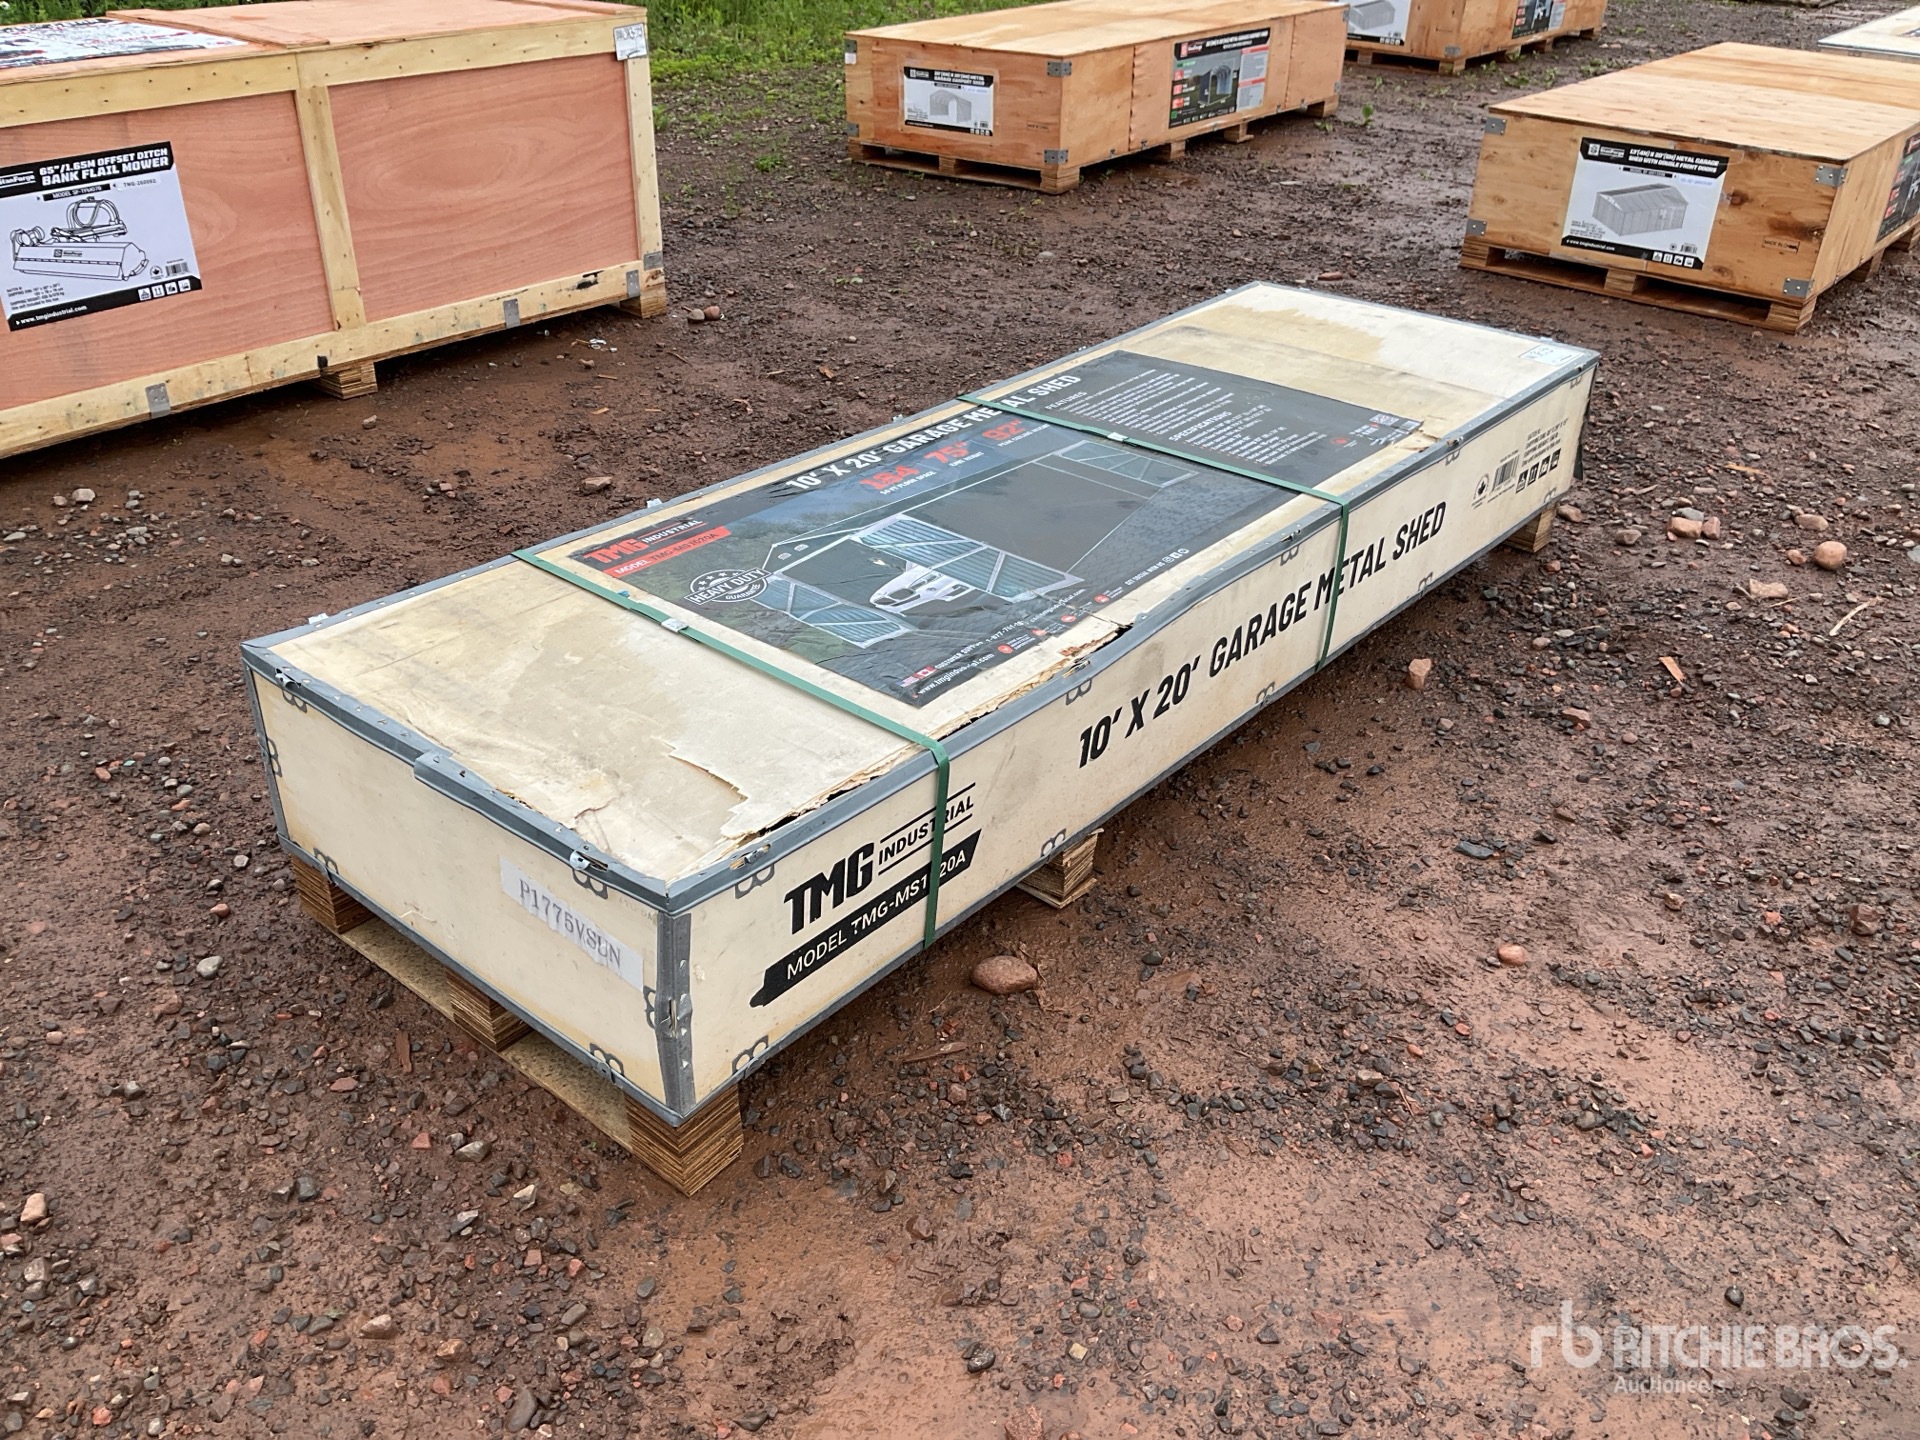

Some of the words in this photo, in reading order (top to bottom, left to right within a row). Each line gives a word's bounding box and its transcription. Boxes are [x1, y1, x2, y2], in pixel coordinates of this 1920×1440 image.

[42, 172, 79, 186] BANK
[82, 163, 119, 180] FLAIL
[122, 156, 169, 172] MOWER
[97, 153, 135, 167] OFFSET
[137, 148, 168, 160] DITCH
[52, 189, 72, 199] MODEL
[20, 304, 88, 324] www.tmgindustrial.com
[1045, 391, 1087, 410] FEATURES
[785, 471, 821, 489] 10'
[821, 464, 851, 477] X
[844, 450, 882, 469] 20'
[882, 418, 973, 453] GARAGE
[963, 395, 1036, 422] MEAL
[1028, 375, 1081, 396] SHED
[1168, 411, 1232, 441] SPECIFICATIONS
[584, 537, 650, 563] TMG
[641, 518, 703, 543] INDUSTRIAL
[614, 559, 653, 574] MODEL
[690, 582, 733, 603] HEAVY
[730, 569, 765, 586] DUTY
[1079, 707, 1122, 768] 10'
[1124, 688, 1151, 739] X
[1153, 656, 1201, 718] 20'
[1209, 580, 1312, 678] GARAGE
[1314, 537, 1387, 611] METAL
[1392, 501, 1447, 560] SHED
[784, 842, 875, 935] TMG
[787, 929, 848, 980] MODEL
[851, 849, 966, 936] TMG-MS120A
